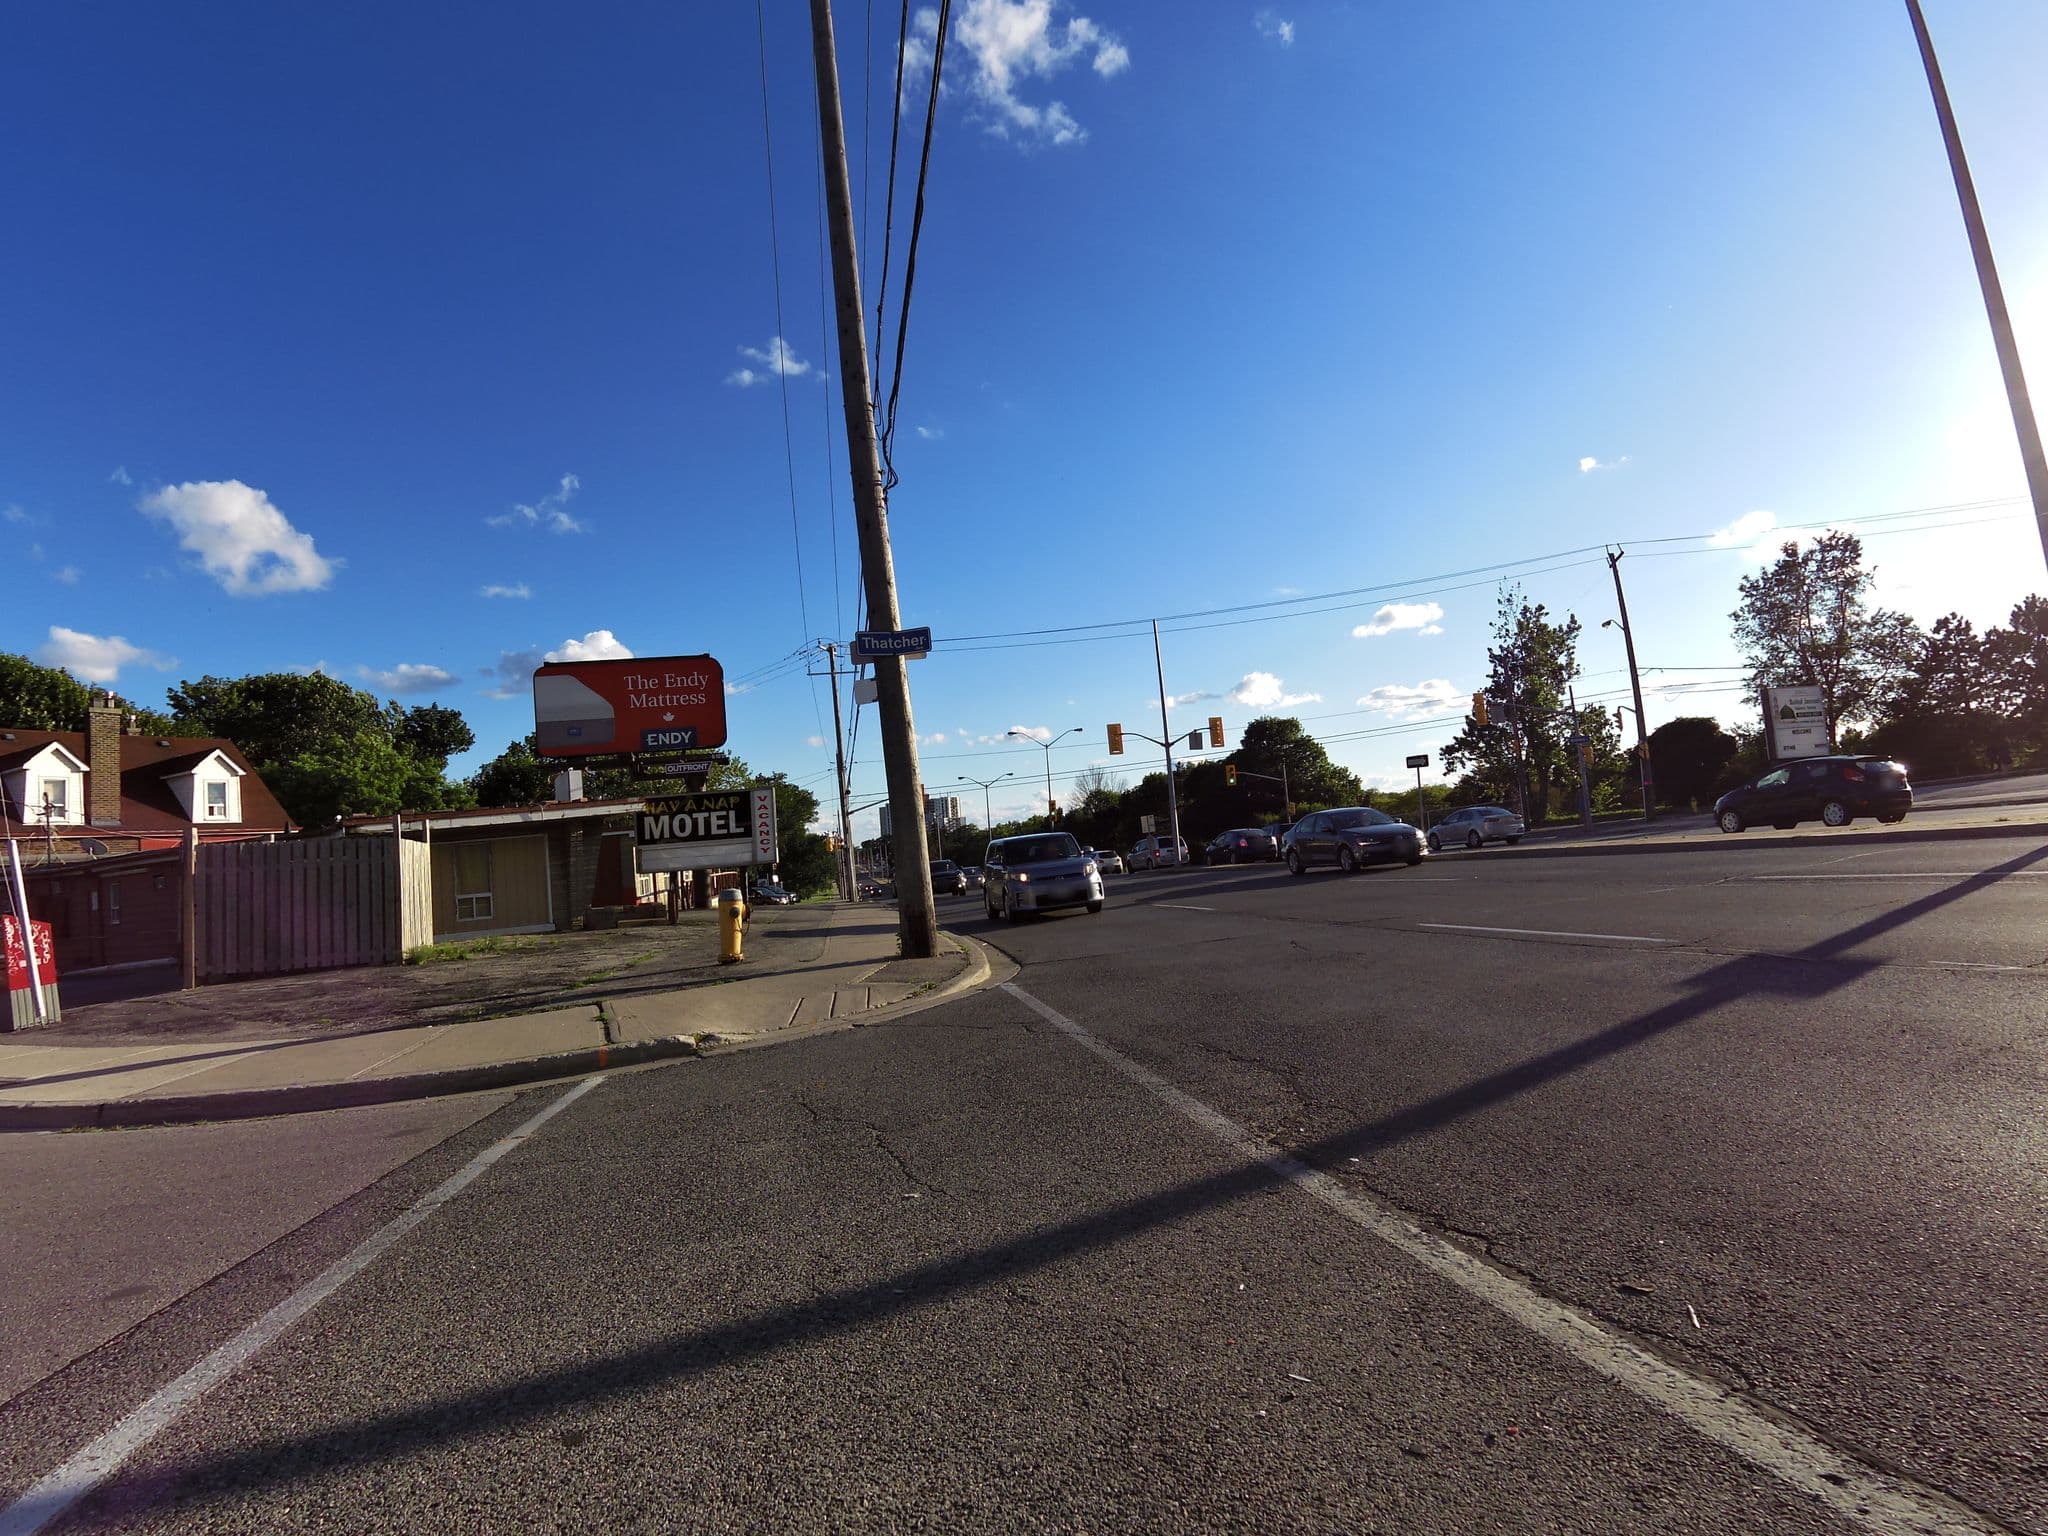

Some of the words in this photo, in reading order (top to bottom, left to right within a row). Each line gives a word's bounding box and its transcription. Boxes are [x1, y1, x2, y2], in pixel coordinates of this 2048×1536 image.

[861, 635, 927, 649] Thatcher
[623, 675, 659, 691] The
[664, 671, 710, 690] Endy
[629, 691, 707, 709] Mattress
[646, 730, 692, 746] ENDY
[666, 762, 710, 773] OUTFRONT
[701, 795, 741, 811] NAP
[643, 810, 745, 840] MOTEL
[757, 795, 771, 854] VACANCY
